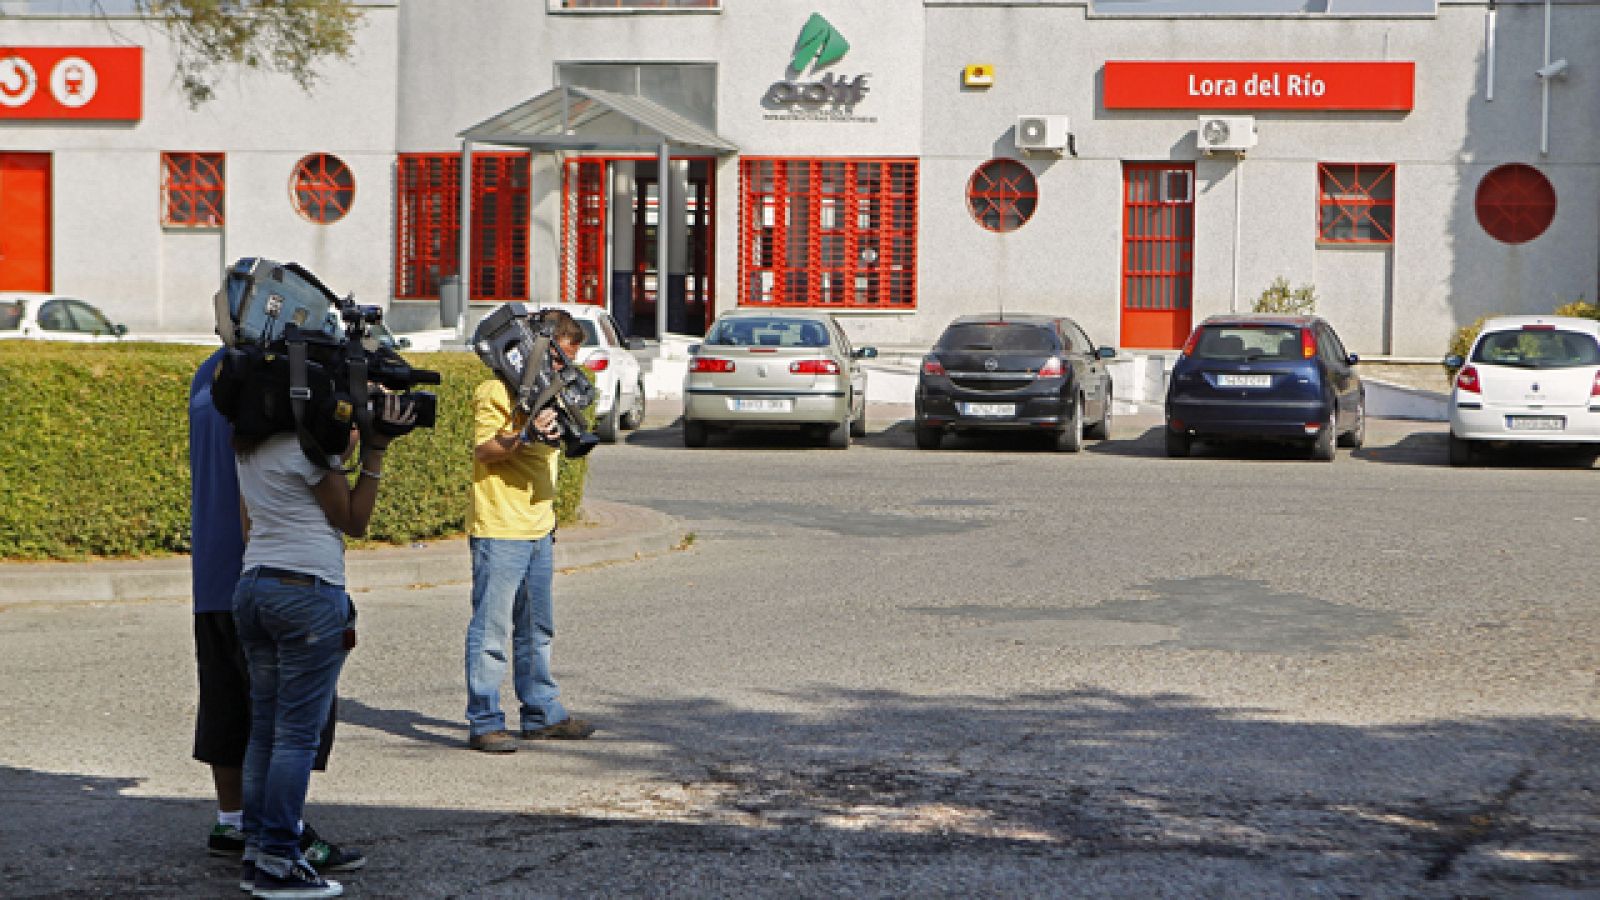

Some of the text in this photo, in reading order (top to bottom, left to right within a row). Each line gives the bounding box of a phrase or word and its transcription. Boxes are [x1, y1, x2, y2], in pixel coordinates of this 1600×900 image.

[1188, 72, 1326, 96] Lora del Río
